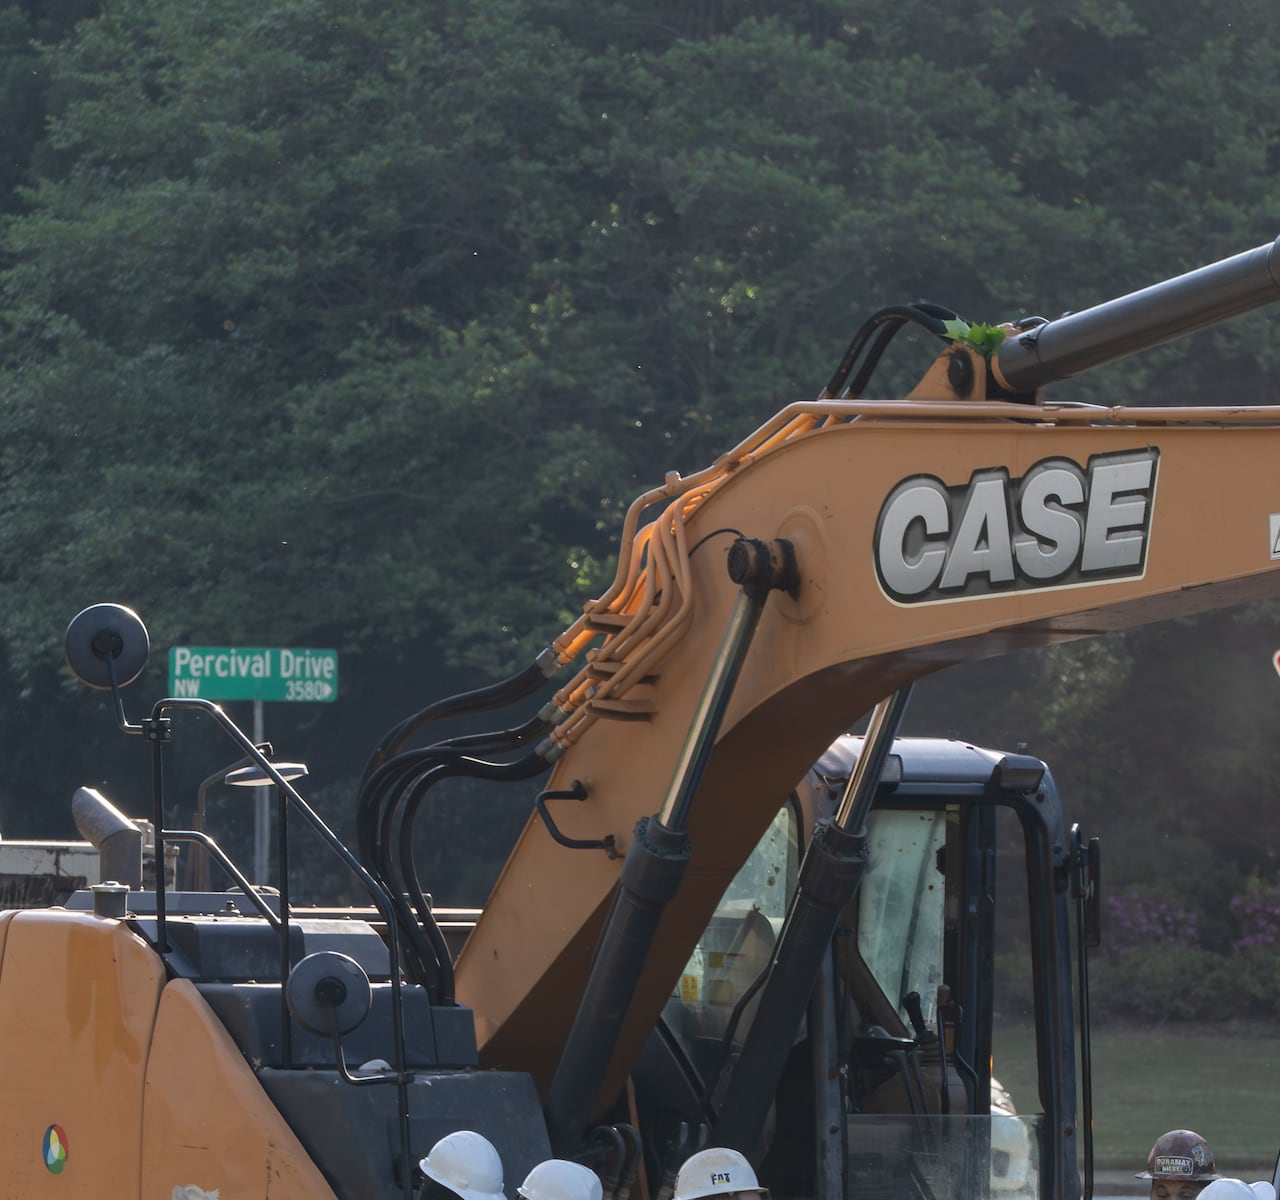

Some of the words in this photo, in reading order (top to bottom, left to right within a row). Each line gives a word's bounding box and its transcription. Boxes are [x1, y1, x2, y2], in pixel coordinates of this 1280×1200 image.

[877, 459, 1156, 596] CASE
[174, 647, 271, 678] Percival
[280, 648, 335, 679] Drive
[174, 679, 200, 698] NW
[285, 680, 322, 701] 3580
